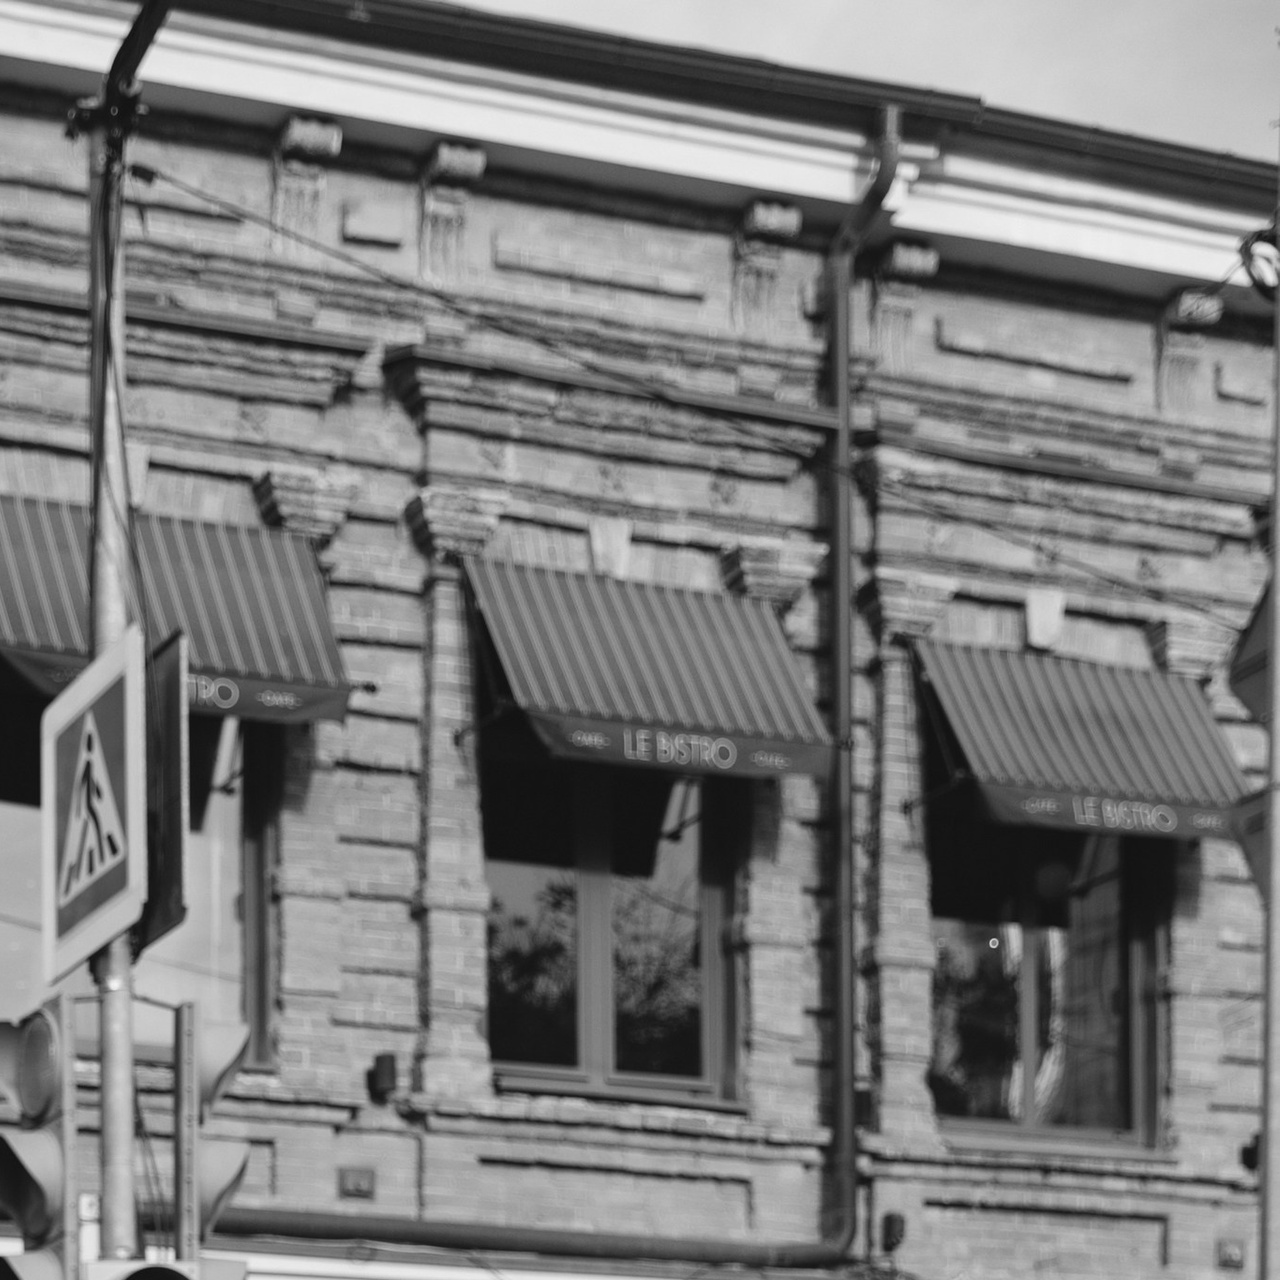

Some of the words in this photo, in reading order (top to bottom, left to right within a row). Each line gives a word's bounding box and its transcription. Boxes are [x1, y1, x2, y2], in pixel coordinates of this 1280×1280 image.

[623, 728, 652, 761] LE
[656, 731, 737, 769] BISTRO
[1072, 796, 1100, 826] LE
[1101, 798, 1178, 832] BISTRO
